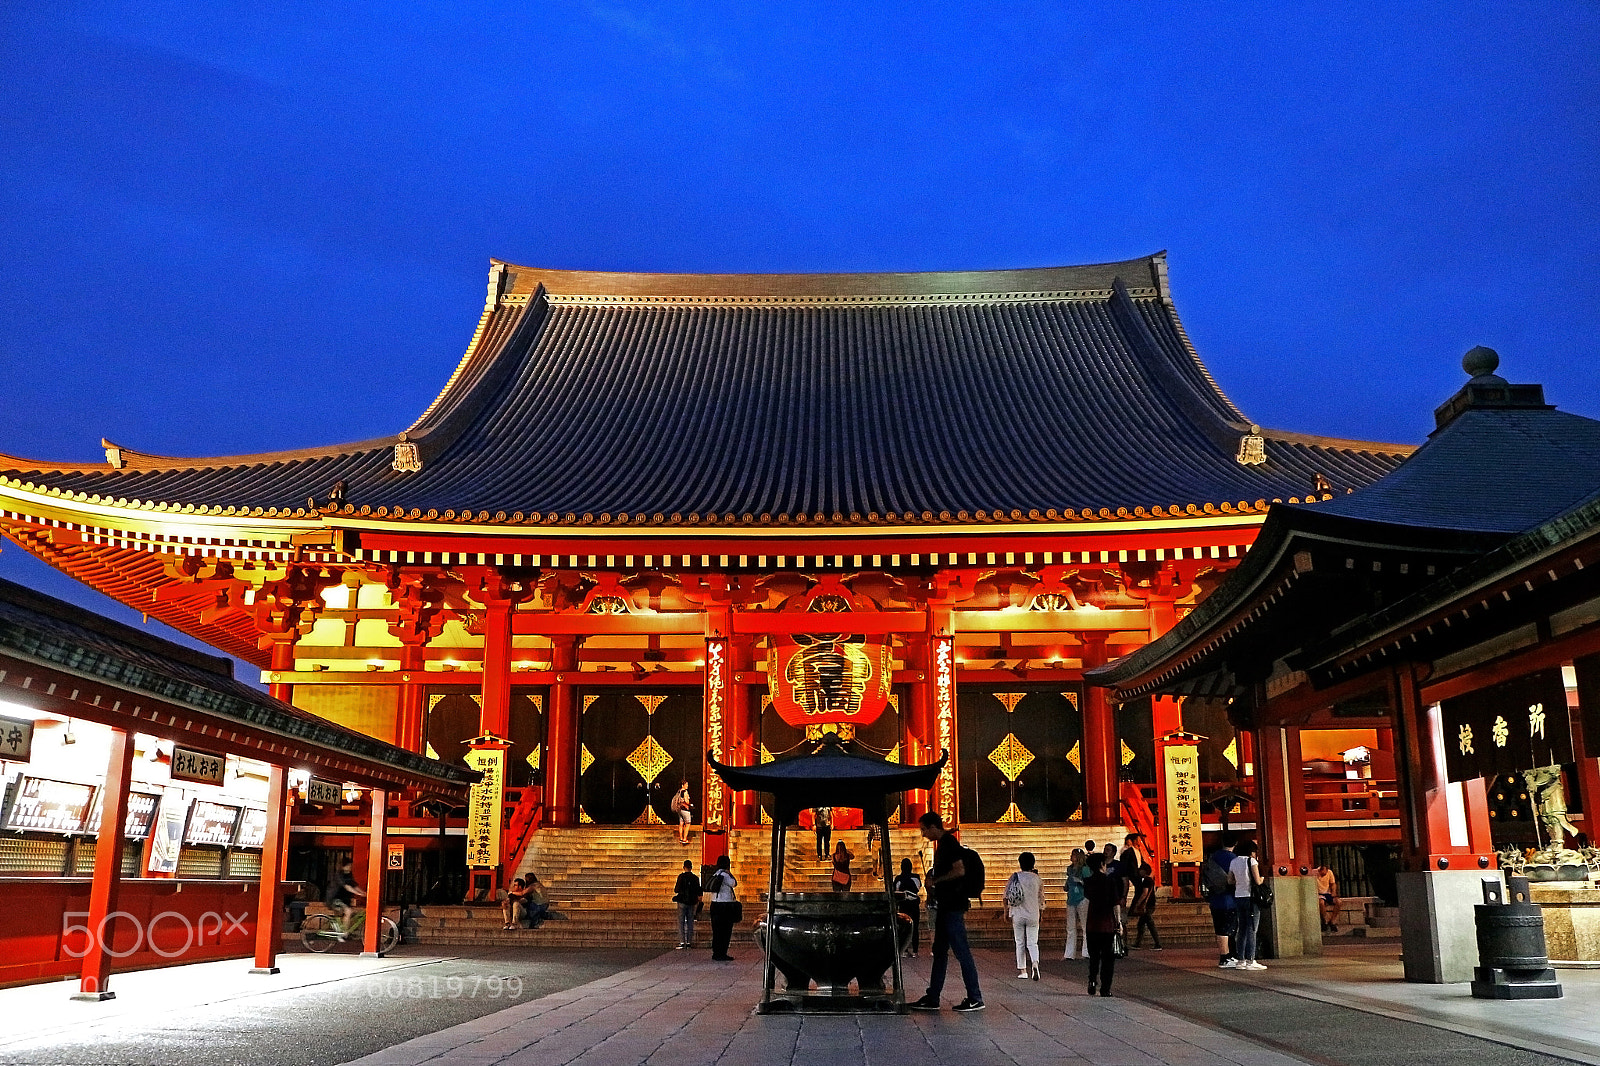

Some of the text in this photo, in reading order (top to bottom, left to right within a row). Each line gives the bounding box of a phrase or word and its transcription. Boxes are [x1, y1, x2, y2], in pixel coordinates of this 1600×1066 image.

[0, 725, 23, 753] 守
[175, 752, 219, 779] お札お守
[310, 783, 339, 803] お札お守
